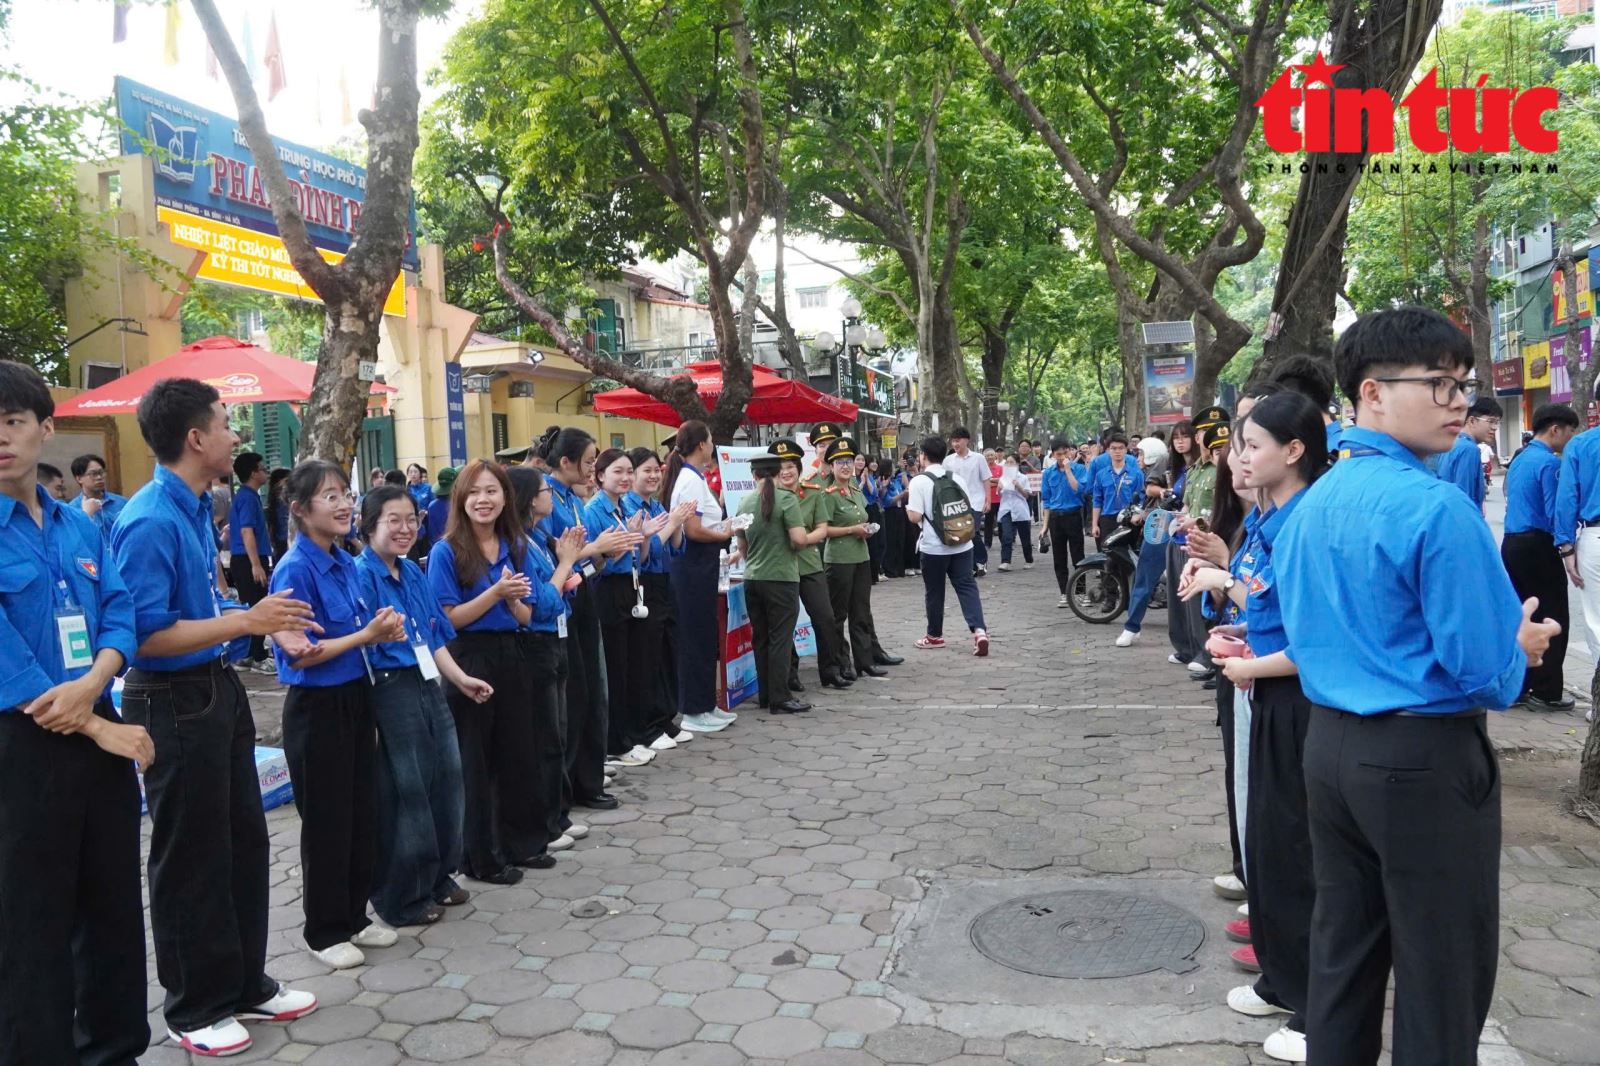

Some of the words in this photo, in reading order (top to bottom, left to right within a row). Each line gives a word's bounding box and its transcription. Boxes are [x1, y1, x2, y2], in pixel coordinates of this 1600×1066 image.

[209, 153, 272, 208] PHA
[279, 146, 311, 170] TRUNG
[313, 160, 336, 179] HỌC
[337, 166, 357, 187] PHỔ
[174, 222, 211, 247] NHIỆT
[213, 233, 238, 253] LIỆT
[240, 240, 270, 260] CHÀO
[211, 250, 229, 270] KỲ
[230, 256, 249, 274] THI
[250, 260, 270, 278] TỐT
[941, 499, 968, 517] VANS
